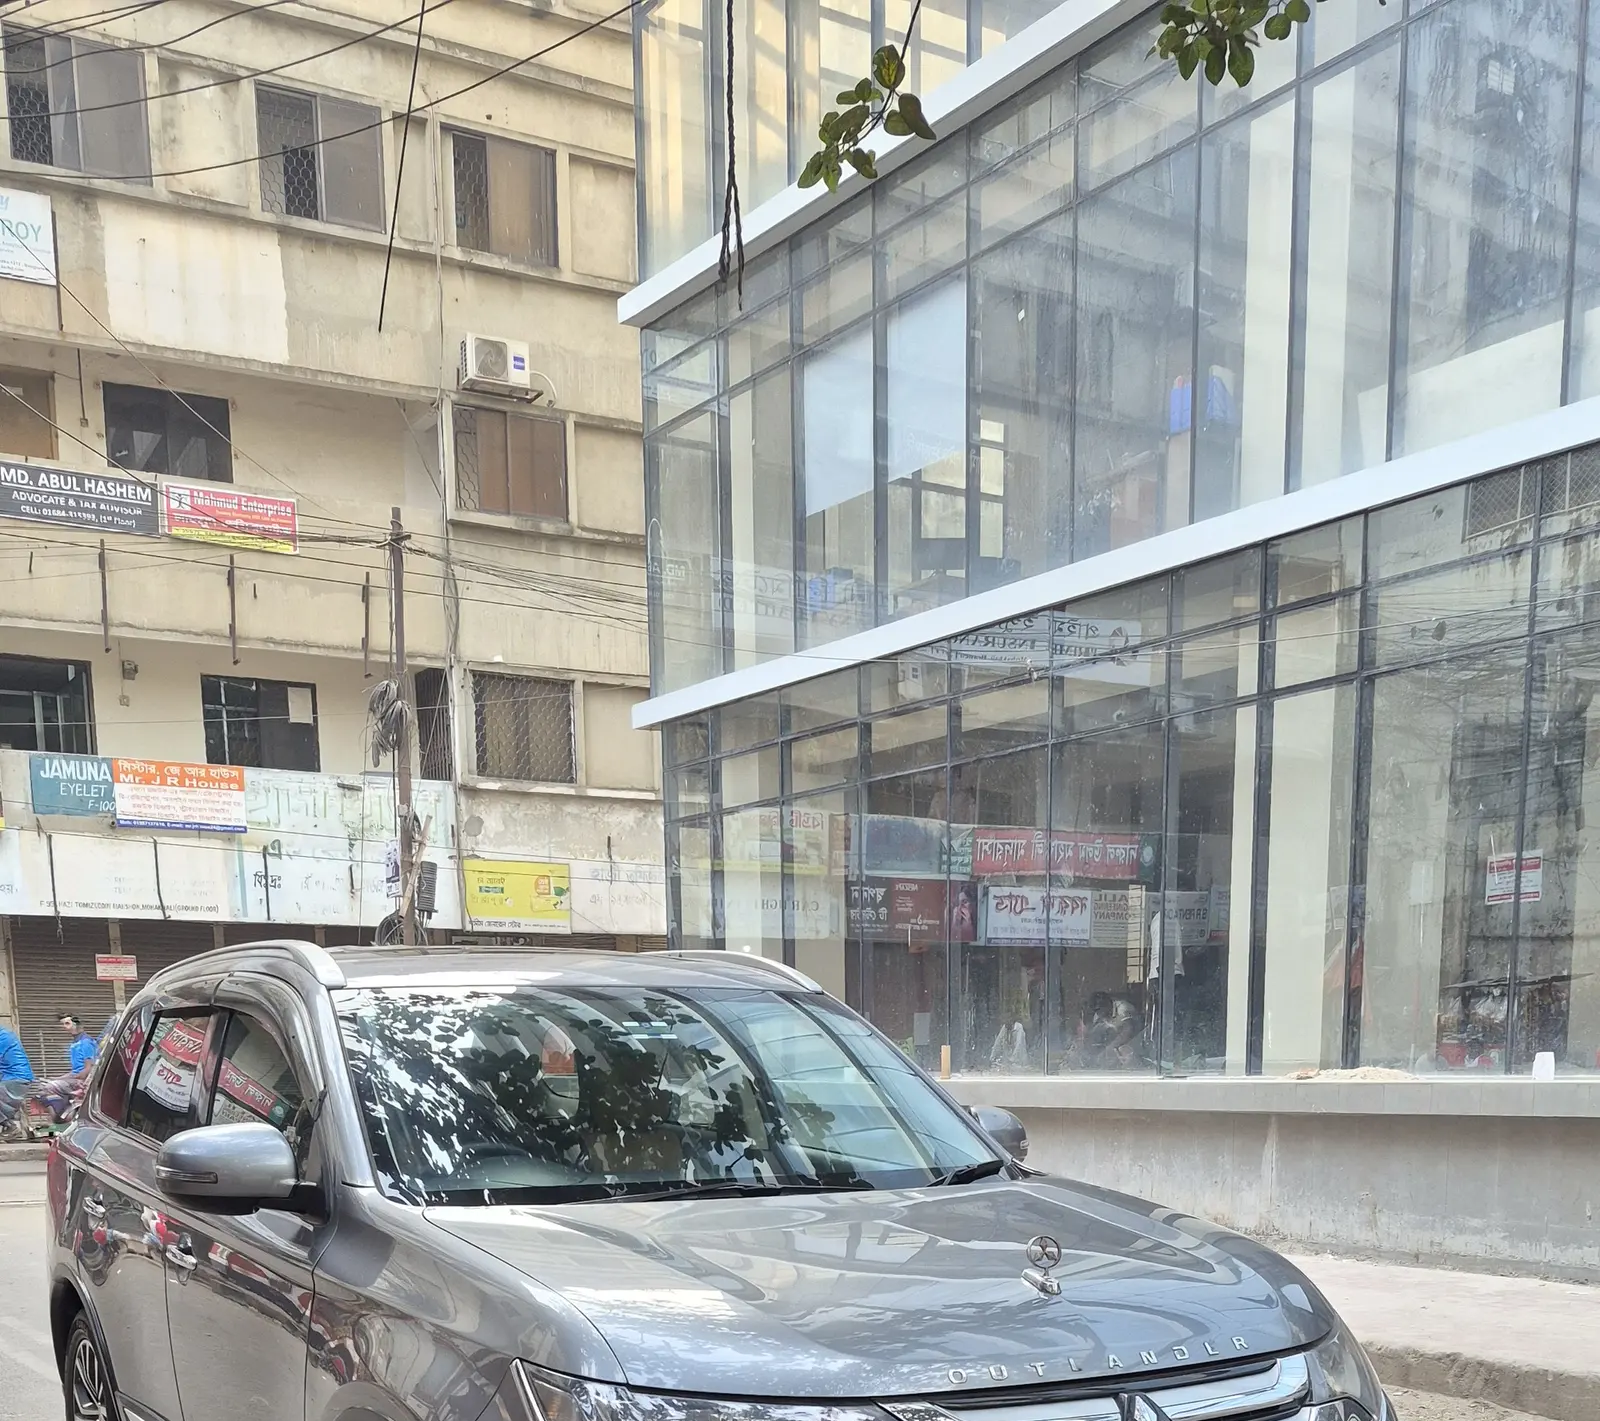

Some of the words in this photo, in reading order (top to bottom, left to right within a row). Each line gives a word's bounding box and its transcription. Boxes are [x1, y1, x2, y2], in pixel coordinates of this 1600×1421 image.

[0, 466, 33, 486] MD.
[38, 472, 81, 492] ABUL
[84, 479, 152, 502] HASHEM
[12, 490, 66, 506] ADVOCATE
[67, 498, 77, 508] &
[79, 500, 97, 510] TAX
[99, 502, 143, 516] ADVISOR
[193, 490, 239, 510] Mahmud
[241, 498, 292, 517] Enterprise
[40, 759, 112, 783] JAMUNA
[119, 774, 146, 784] Mr.
[149, 776, 161, 786] J
[167, 776, 180, 787] R
[184, 778, 240, 790] House
[164, 766, 181, 777] জে
[184, 766, 206, 778] আর
[209, 767, 240, 781] হাউস
[60, 783, 108, 798] EYELET
[947, 1335, 1250, 1385] OUTLANDER
